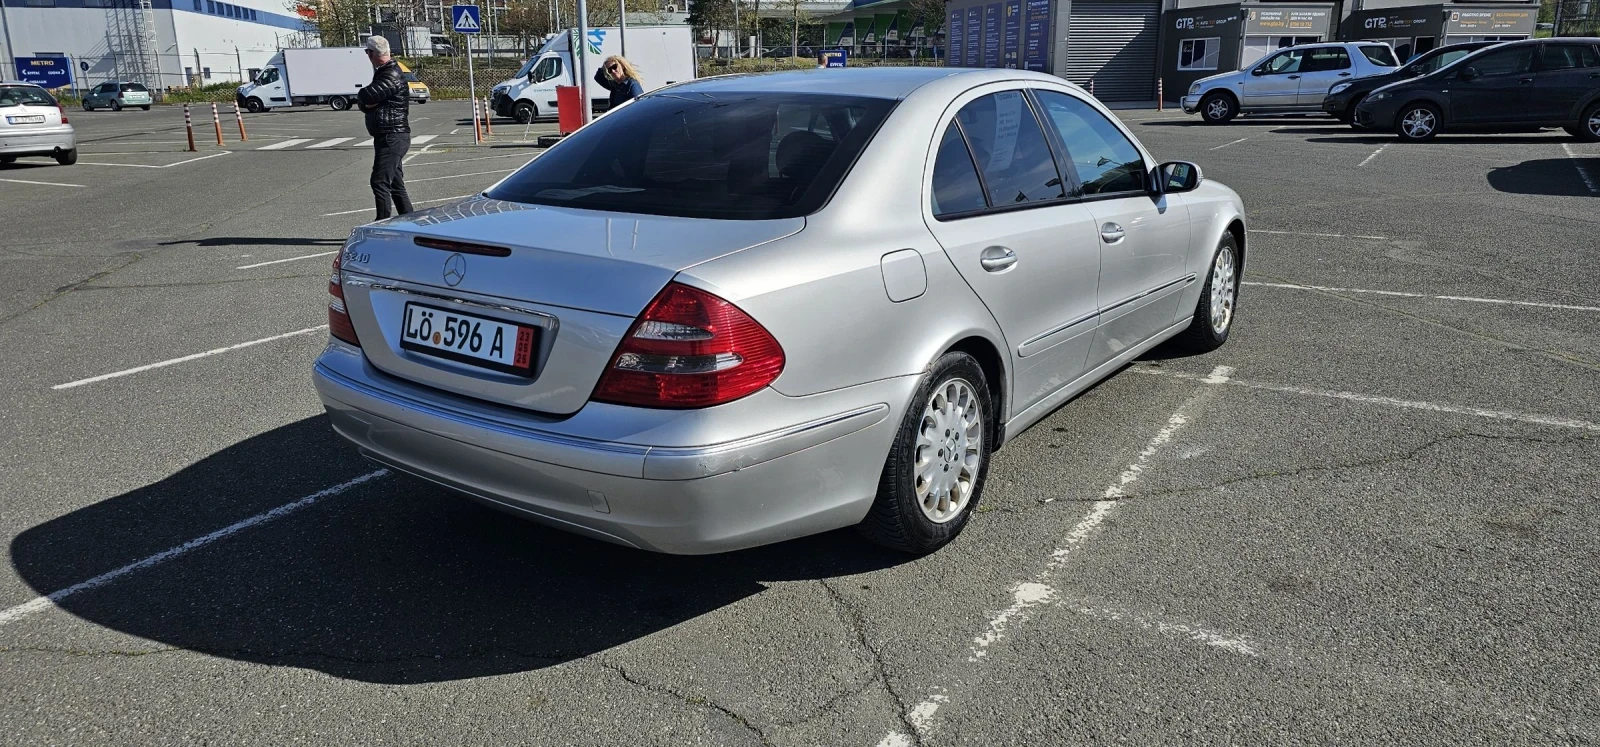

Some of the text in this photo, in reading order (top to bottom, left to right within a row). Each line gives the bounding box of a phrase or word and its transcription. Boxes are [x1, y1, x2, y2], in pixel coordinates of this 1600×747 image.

[406, 308, 503, 359] LÖ 596 A
[519, 331, 530, 341] 23
